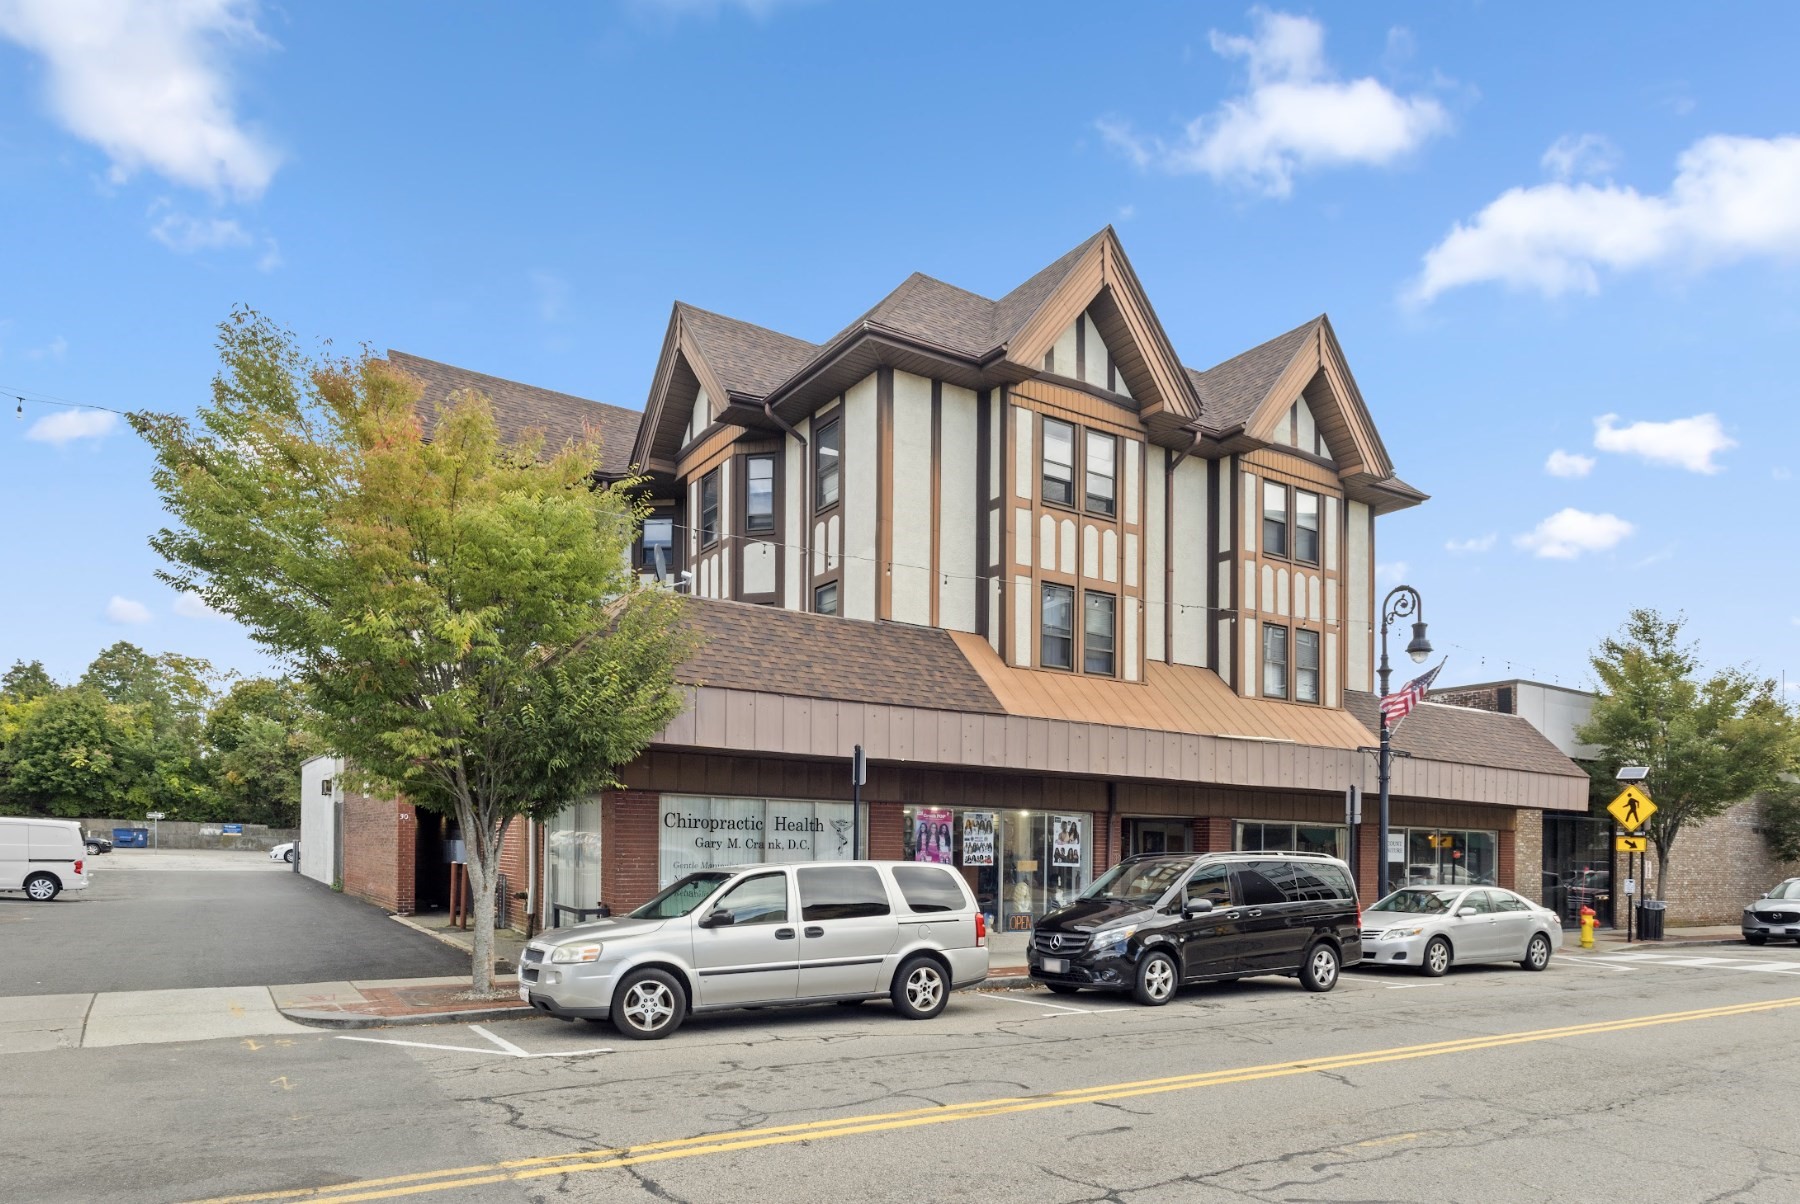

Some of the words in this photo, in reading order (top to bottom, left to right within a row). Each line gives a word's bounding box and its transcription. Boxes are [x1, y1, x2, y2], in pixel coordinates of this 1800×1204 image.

[664, 812, 763, 832] Chiropractic
[774, 816, 824, 832] Health
[695, 837, 722, 850] Gary
[727, 838, 741, 849] M.
[788, 839, 810, 850] D.C.
[673, 861, 698, 869] Gentle
[1010, 915, 1032, 930] OPEN
